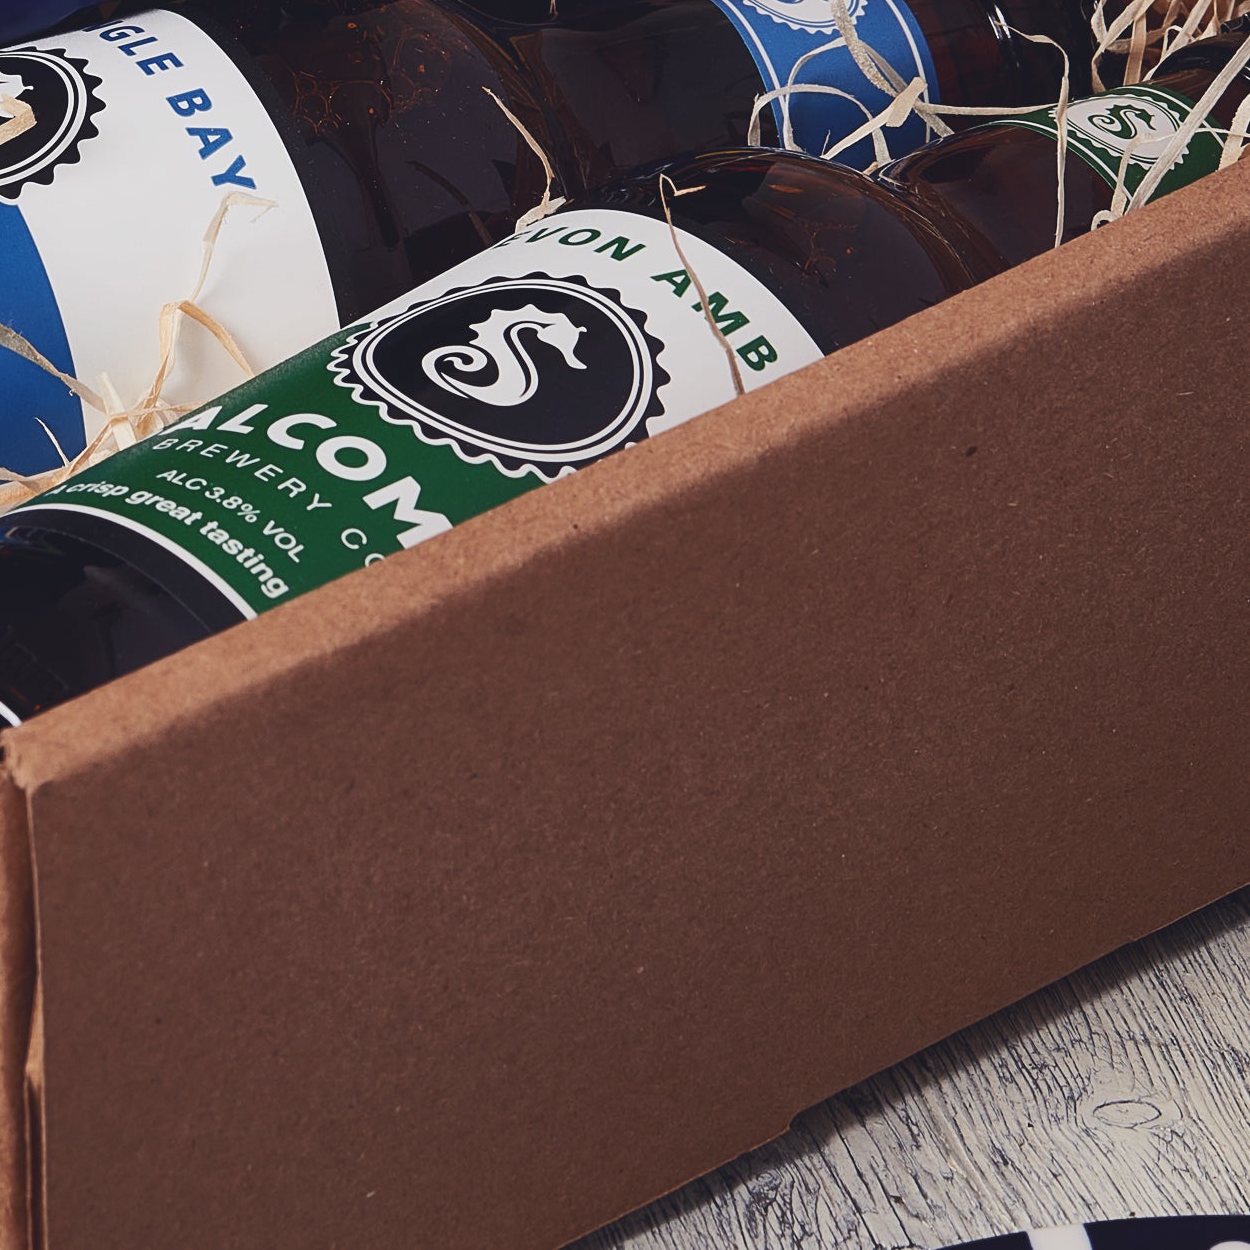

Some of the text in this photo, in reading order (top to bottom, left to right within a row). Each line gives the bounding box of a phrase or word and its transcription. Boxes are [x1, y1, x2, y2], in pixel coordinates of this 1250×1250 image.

[82, 20, 258, 190] GLE BAY
[650, 268, 779, 372] AMB
[152, 438, 333, 513] BREWERY
[156, 469, 307, 564] ALC 3.8% VOL
[66, 481, 130, 497] crisp
[125, 490, 203, 526] great
[200, 520, 290, 600] tasting
